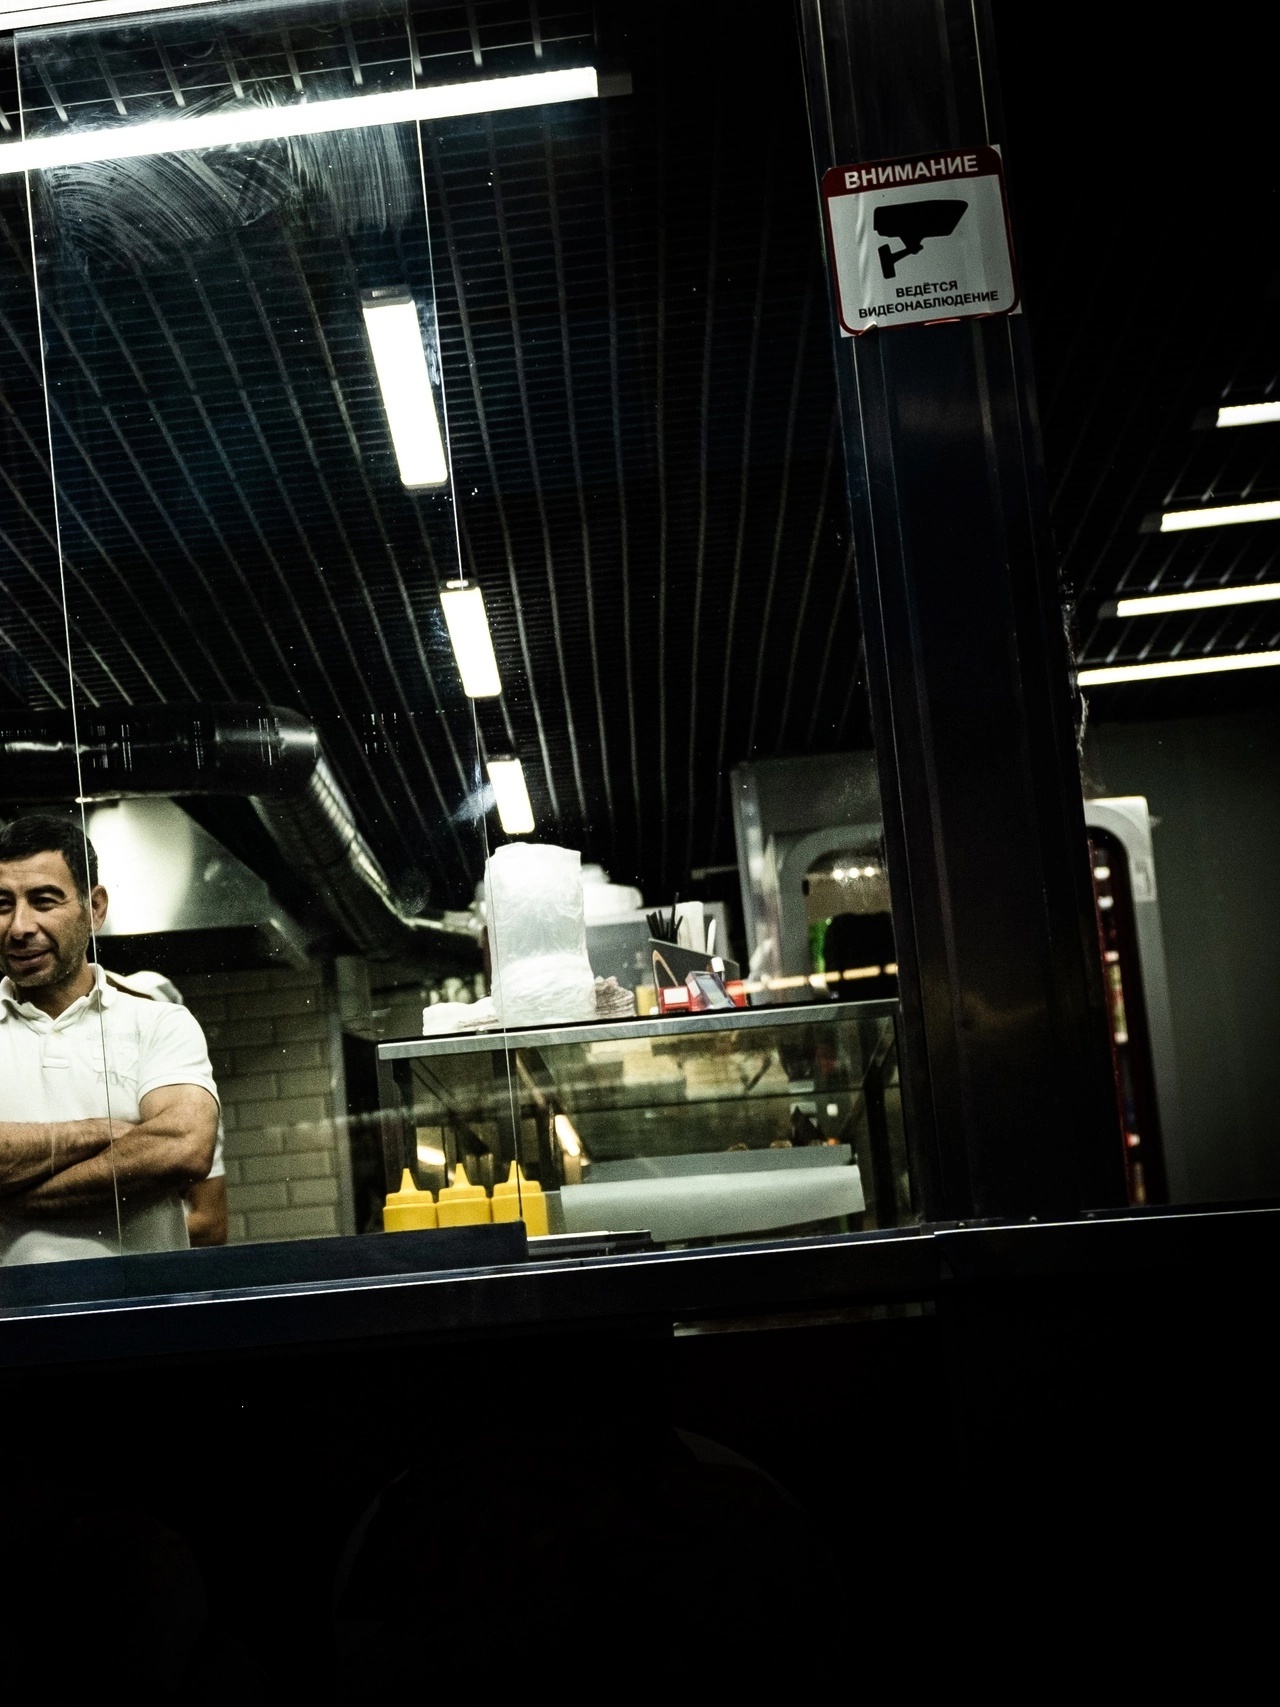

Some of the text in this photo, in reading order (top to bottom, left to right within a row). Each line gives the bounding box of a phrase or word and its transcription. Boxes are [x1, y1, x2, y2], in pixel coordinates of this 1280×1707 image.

[844, 155, 979, 189] ВНИМАНИЕ
[896, 280, 958, 298] ВЕДЁТСЯ
[858, 291, 999, 318] ВИДЕОНАБЛЮДЕНИЕ
